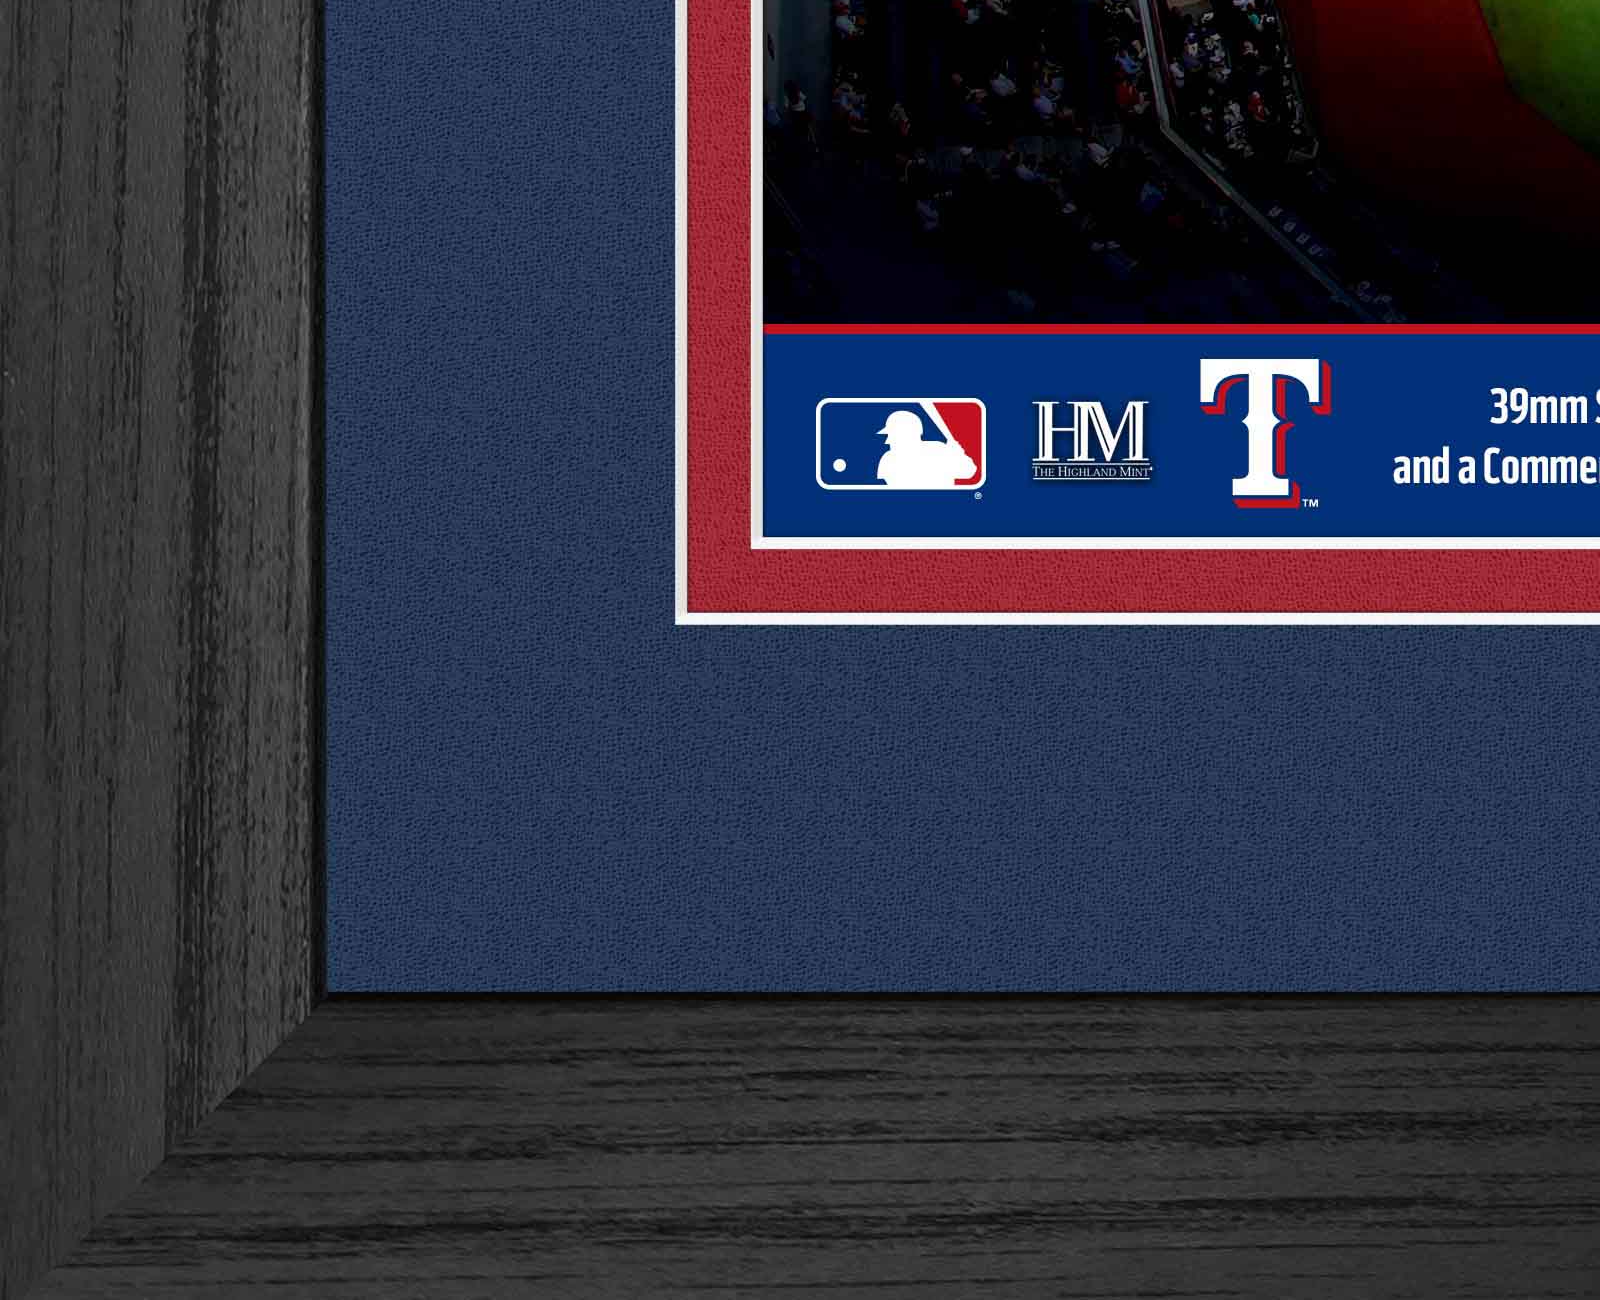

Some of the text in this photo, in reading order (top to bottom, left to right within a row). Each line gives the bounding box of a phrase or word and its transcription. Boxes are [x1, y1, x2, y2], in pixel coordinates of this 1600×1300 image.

[1490, 387, 1588, 425] 39mm
[1032, 401, 1149, 463] HM
[1200, 358, 1331, 507] T
[1033, 466, 1149, 477] THE HIGHLAND MINT
[1393, 446, 1450, 484] and
[1458, 455, 1476, 485] a
